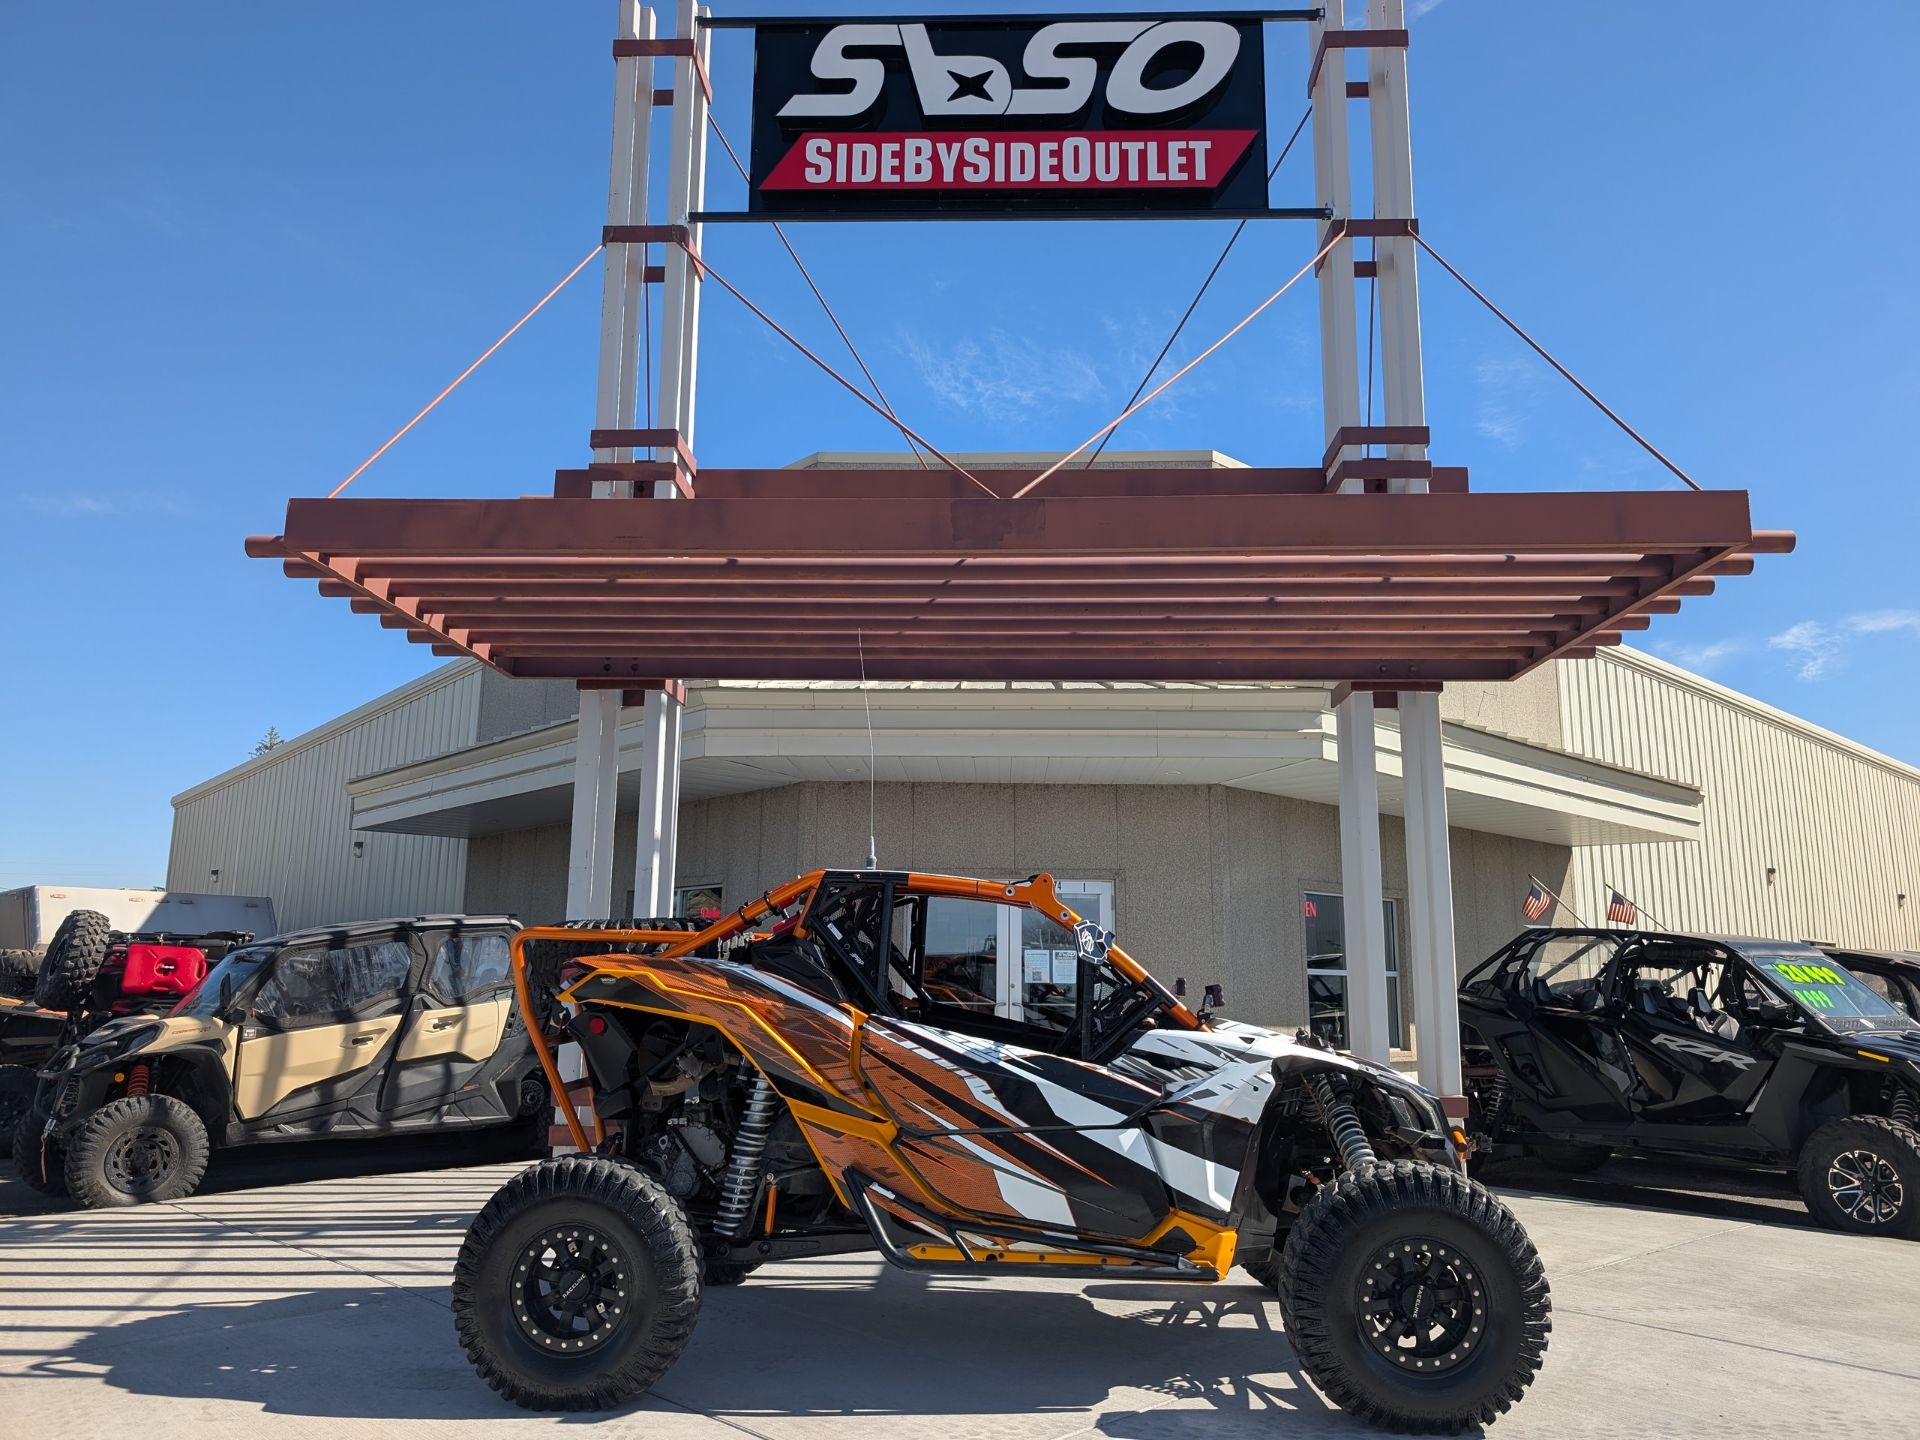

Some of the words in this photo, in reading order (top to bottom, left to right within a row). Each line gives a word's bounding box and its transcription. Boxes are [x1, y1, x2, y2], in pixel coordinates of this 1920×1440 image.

[1303, 901, 1317, 917] EN
[1650, 1033, 1757, 1070] RZR
[562, 1273, 586, 1299] RACELINE
[1412, 1285, 1424, 1319] RACELINE
